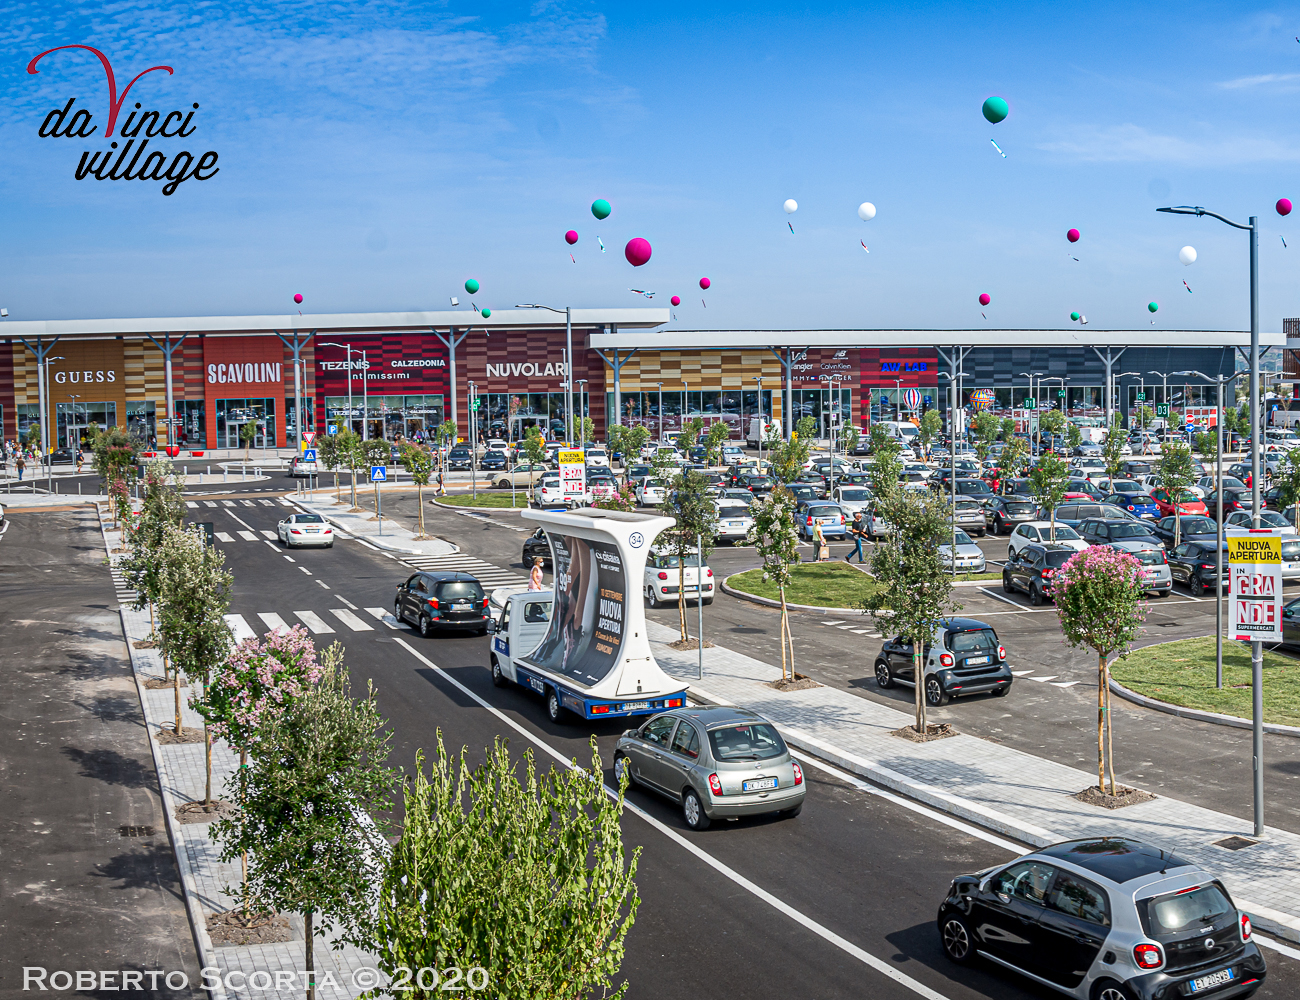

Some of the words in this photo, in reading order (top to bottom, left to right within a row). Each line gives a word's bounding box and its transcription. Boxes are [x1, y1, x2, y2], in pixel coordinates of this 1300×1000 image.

[208, 362, 281, 384] SCAVOLINI
[486, 363, 569, 377] NUVOLARI
[881, 362, 901, 372] AW
[905, 362, 928, 372] LAB
[55, 370, 116, 383] GUESS
[1025, 399, 1033, 408] D1
[1157, 405, 1167, 415] D3
[631, 535, 642, 545] 34
[1237, 541, 1271, 551] NUOVA
[1230, 551, 1281, 561] APERTURA
[559, 572, 567, 592] 99
[1236, 573, 1275, 596] GRA
[600, 598, 622, 621] NUOVA
[1236, 601, 1275, 624] NDE
[598, 617, 621, 635] APERTURA
